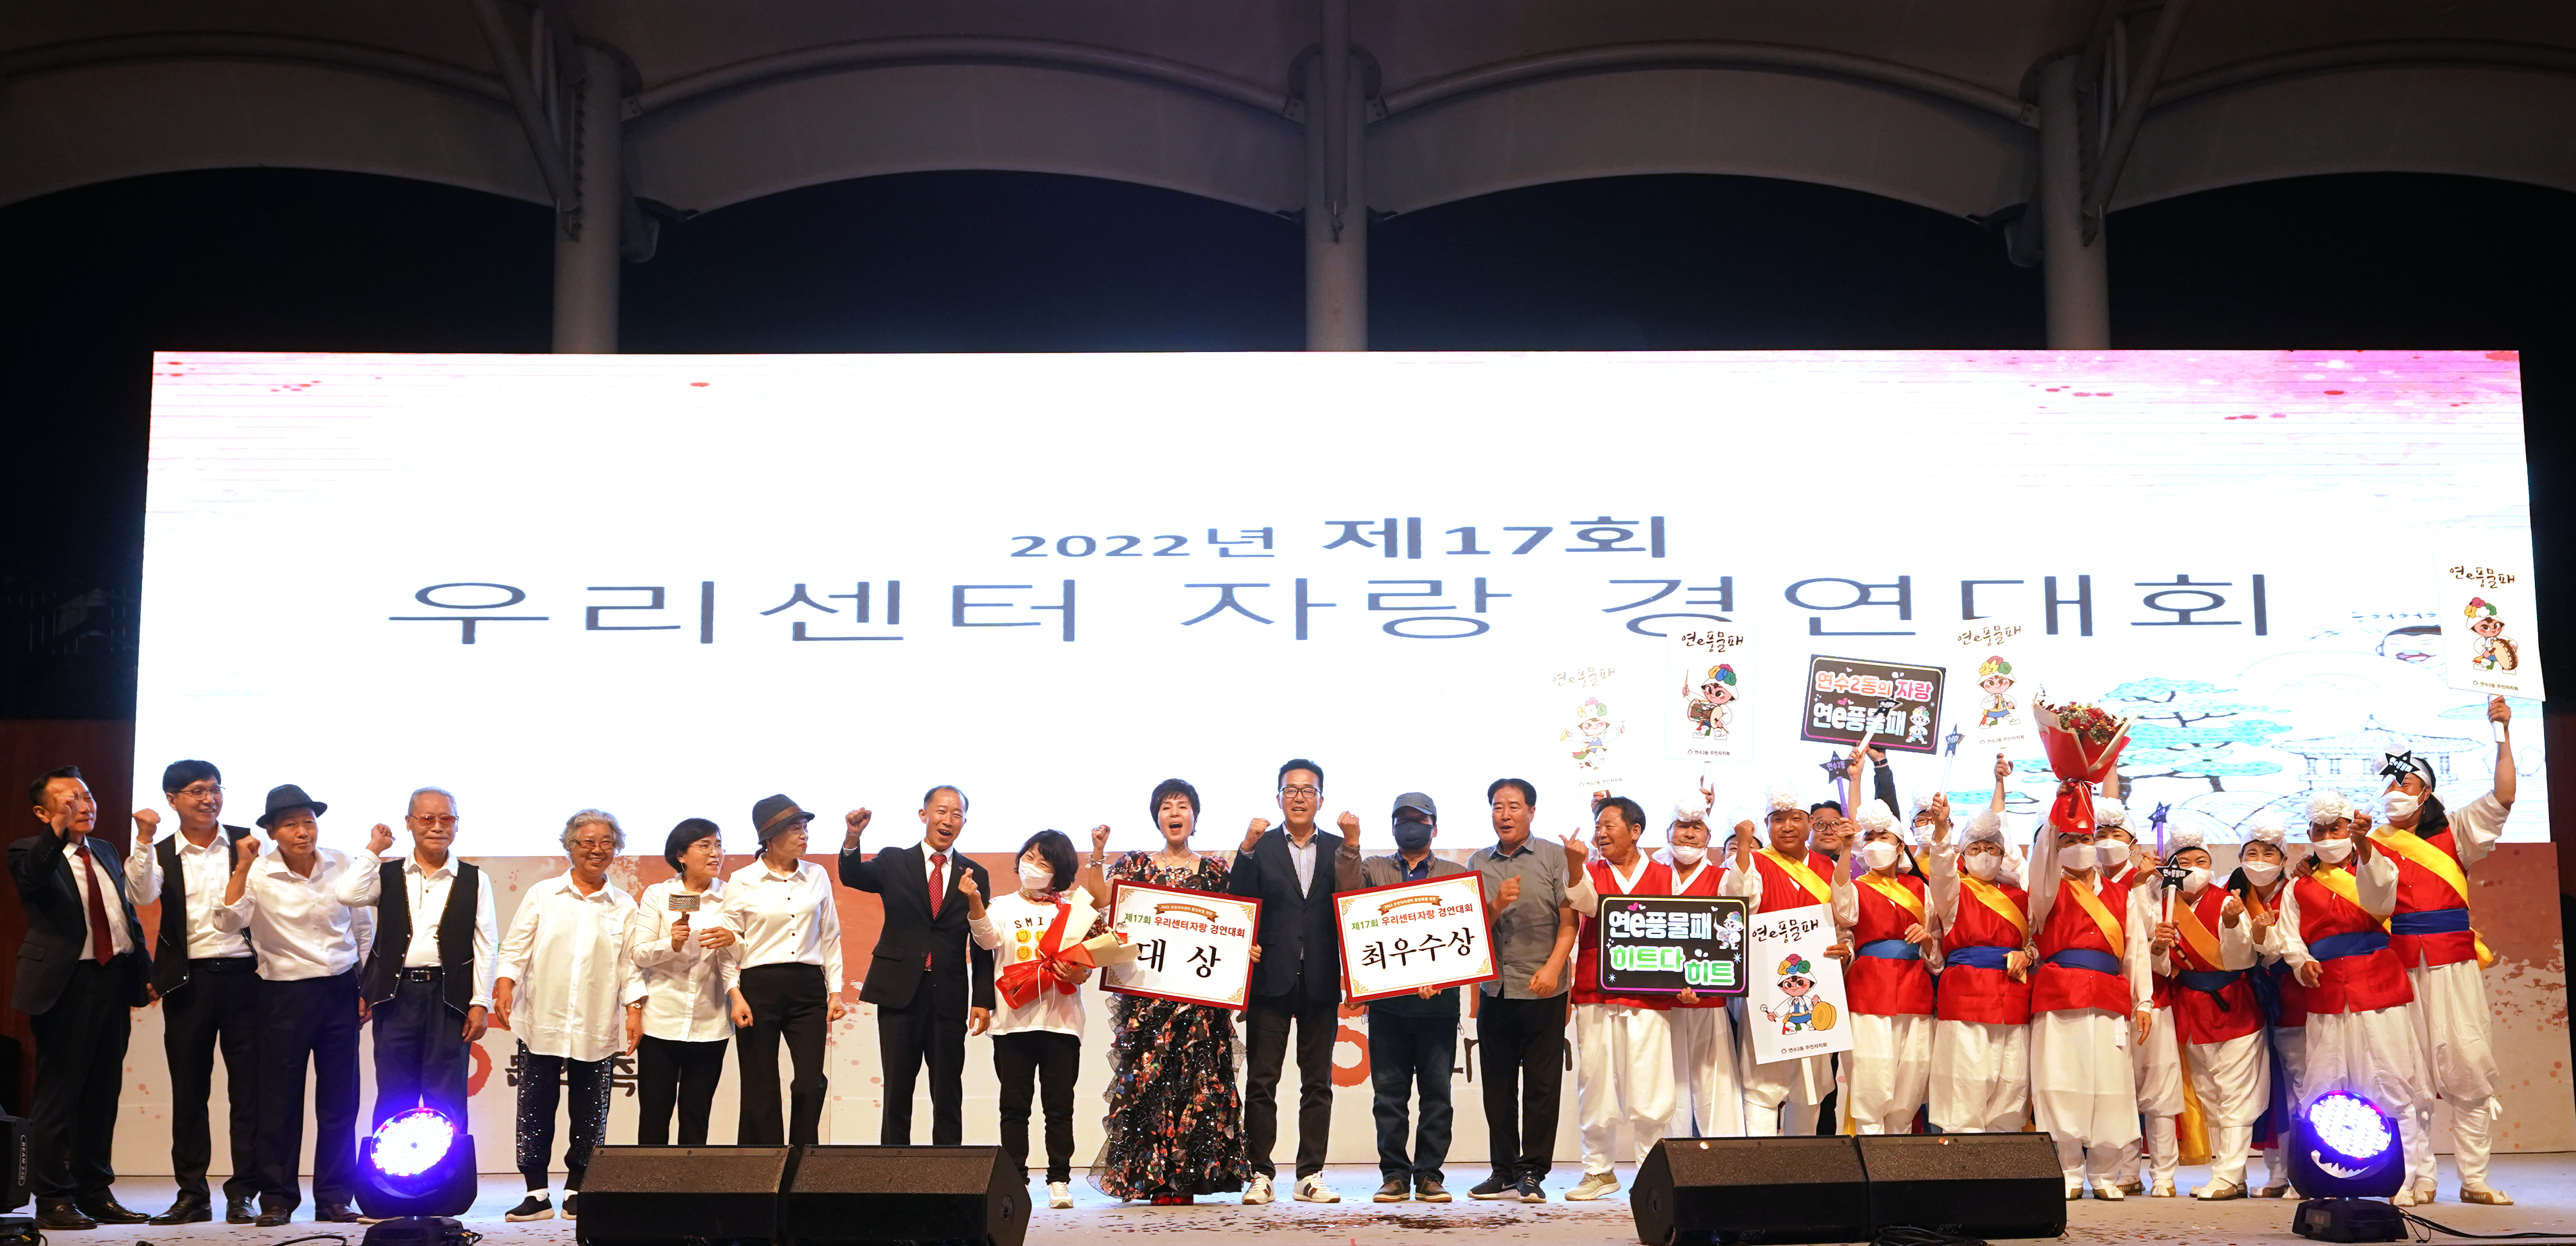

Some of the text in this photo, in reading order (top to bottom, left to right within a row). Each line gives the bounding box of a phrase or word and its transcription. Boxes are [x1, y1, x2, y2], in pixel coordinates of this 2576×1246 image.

[1011, 516, 1665, 559] 2022년 제17회
[2449, 566, 2515, 589] 연e풍물패
[389, 574, 2267, 644] 우리센터 자랑 경연대회
[1681, 631, 1744, 653] 연e풍물패
[1957, 625, 2021, 646] 연e풍물패
[1552, 667, 1615, 688] 연e풍물패
[1816, 672, 1933, 700] 연수2동의 자랑
[1014, 917, 1054, 928] SMI
[1124, 913, 1151, 925] 제17회
[1210, 924, 1245, 938] 경연대회
[1352, 919, 1378, 930] 제17회
[1438, 903, 1473, 917] 경연대회
[1609, 911, 1712, 940] 연e풍물패
[1752, 919, 1819, 943] 연e풍물패
[1361, 927, 1475, 969] 최우수상
[1610, 945, 1735, 985] 히트다 히트
